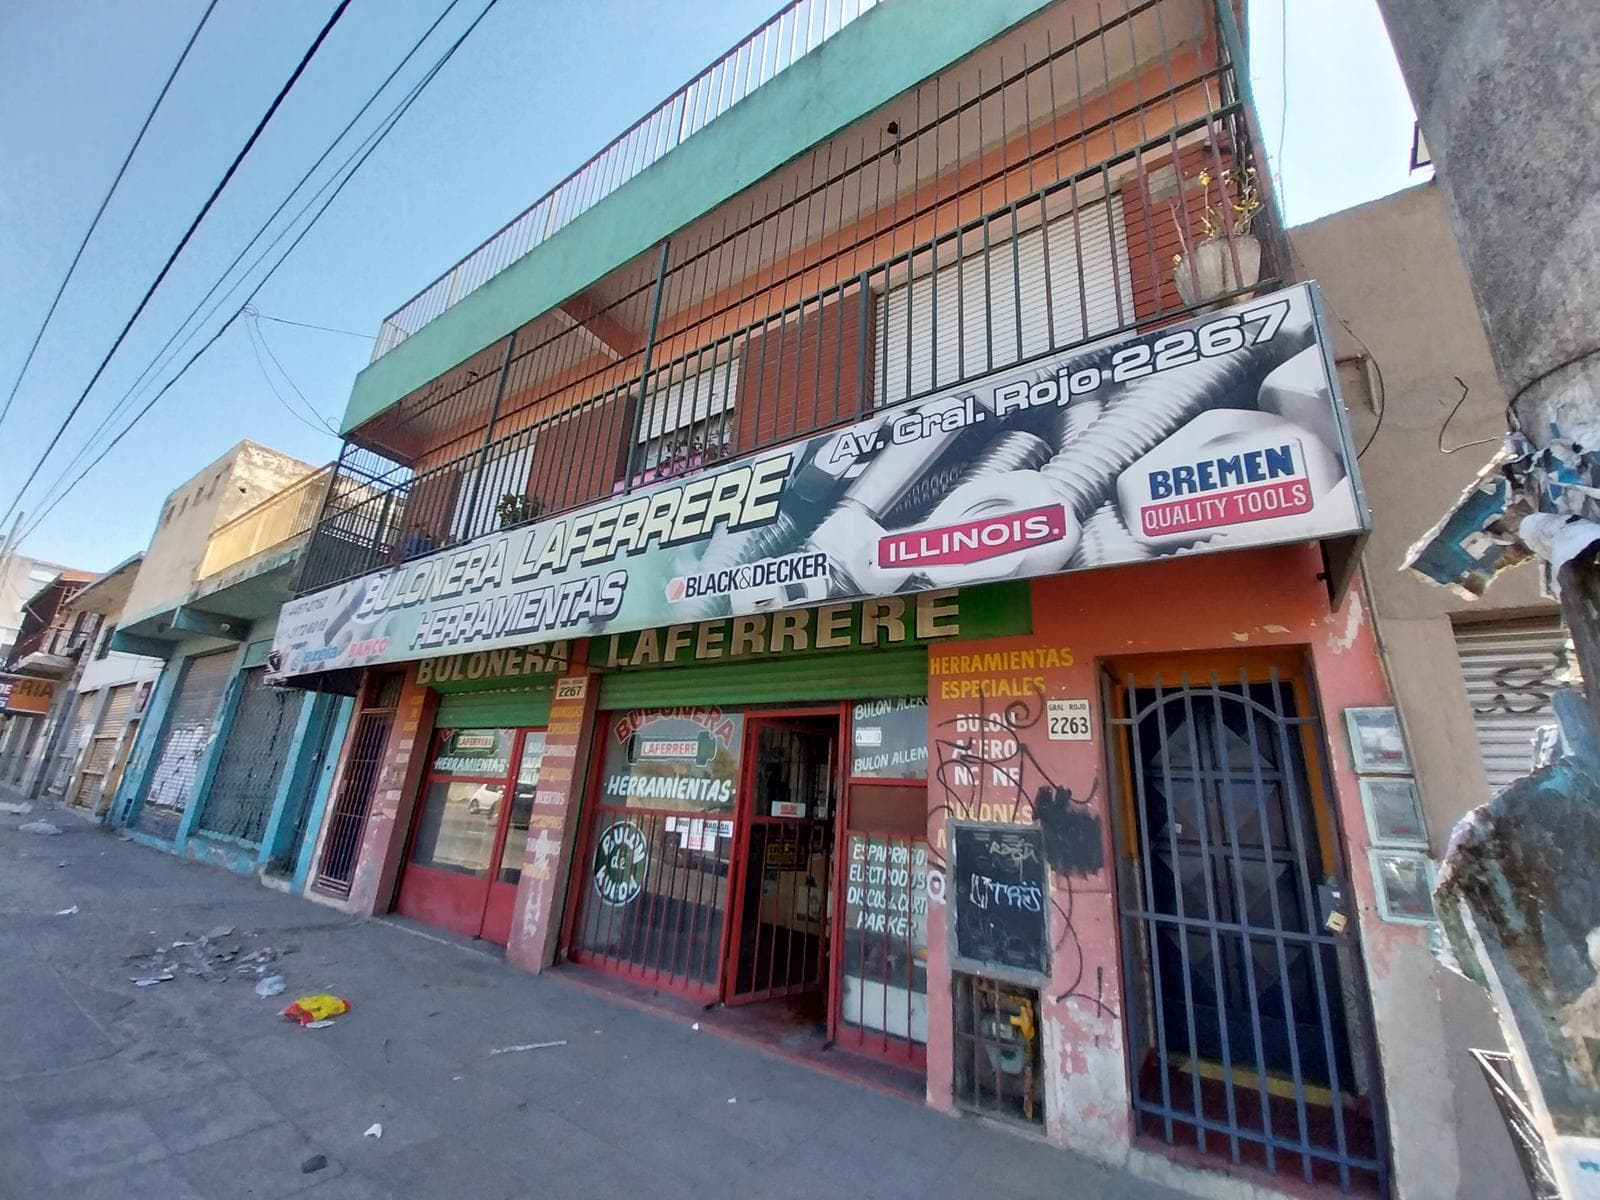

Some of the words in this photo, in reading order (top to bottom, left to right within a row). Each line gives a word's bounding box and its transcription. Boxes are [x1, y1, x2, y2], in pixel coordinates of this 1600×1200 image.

[829, 432, 884, 463] Av.
[892, 398, 985, 446] Gral.
[994, 366, 1102, 416] Rojo
[1111, 298, 1291, 384] 2267
[1148, 444, 1296, 500] BREMEN
[1145, 497, 1228, 530] QUALITY
[1233, 484, 1307, 516] TOOLS
[356, 538, 509, 618] BULONERA
[508, 452, 795, 584] LAFERRERE
[685, 552, 828, 598] BLACK&DECKER
[409, 569, 628, 651] HERRAMIENTAS
[416, 641, 568, 685] BULONERA
[607, 587, 960, 668] LAFERRERE
[930, 647, 1074, 676] HERRAMIENTAS
[558, 685, 582, 697] 2267
[941, 676, 1046, 700] ESPECIALES
[855, 700, 892, 720] BULON
[1048, 703, 1065, 711] GRAL
[1069, 703, 1087, 711] ROJO
[956, 712, 1017, 734] BULON
[1050, 717, 1089, 735] 2263
[642, 742, 698, 755] LAFERRERE
[951, 737, 1018, 760] ACERO
[434, 757, 507, 773] HERRAMIENTAS
[854, 753, 889, 774] BULON
[954, 766, 979, 786] NC
[607, 775, 732, 803] HERRAMIENTAS
[611, 848, 626, 870] de
[853, 843, 928, 867] ESPARRAO
